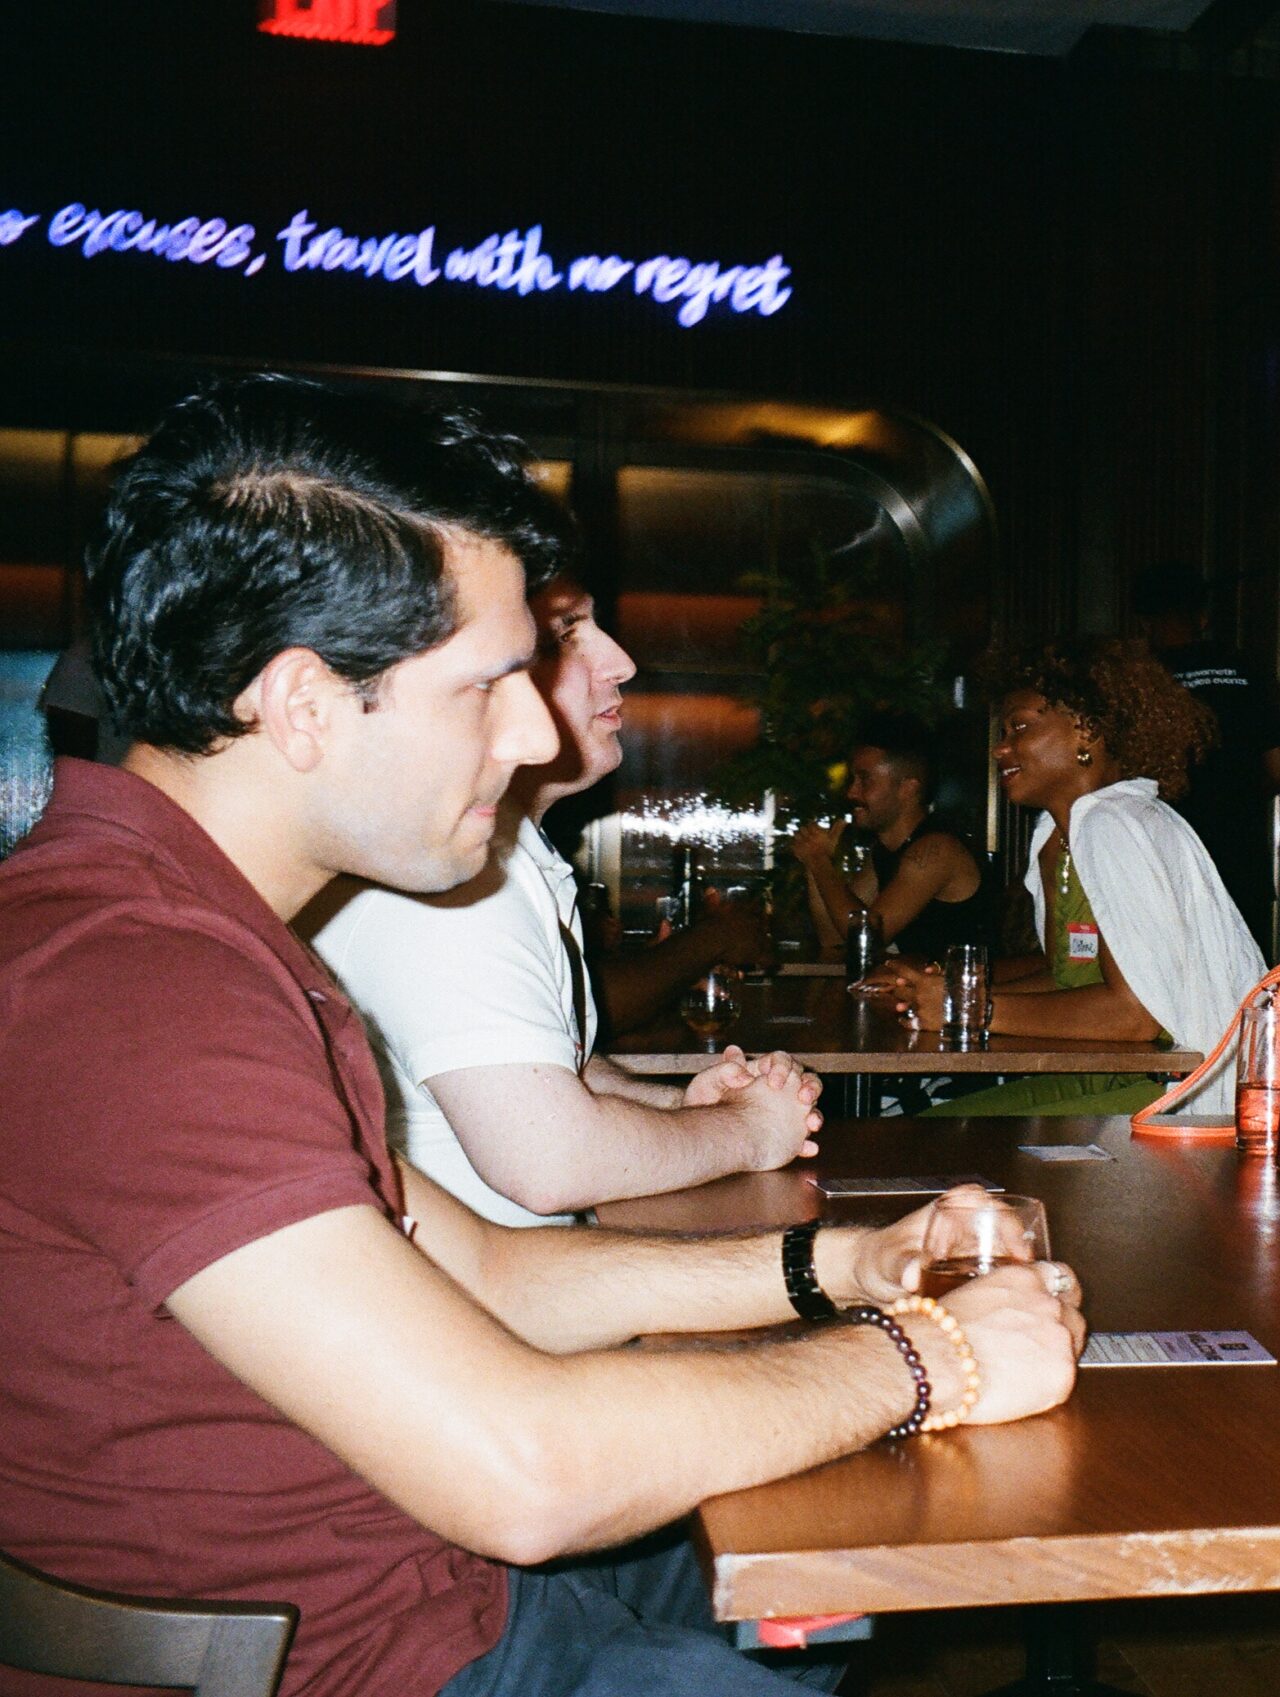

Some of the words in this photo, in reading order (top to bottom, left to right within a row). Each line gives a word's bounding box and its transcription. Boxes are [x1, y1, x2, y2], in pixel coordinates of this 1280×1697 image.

[47, 202, 266, 277] excuses,
[276, 208, 441, 286] travel
[444, 223, 563, 296] with
[568, 254, 634, 291] no
[634, 253, 792, 328] regret
